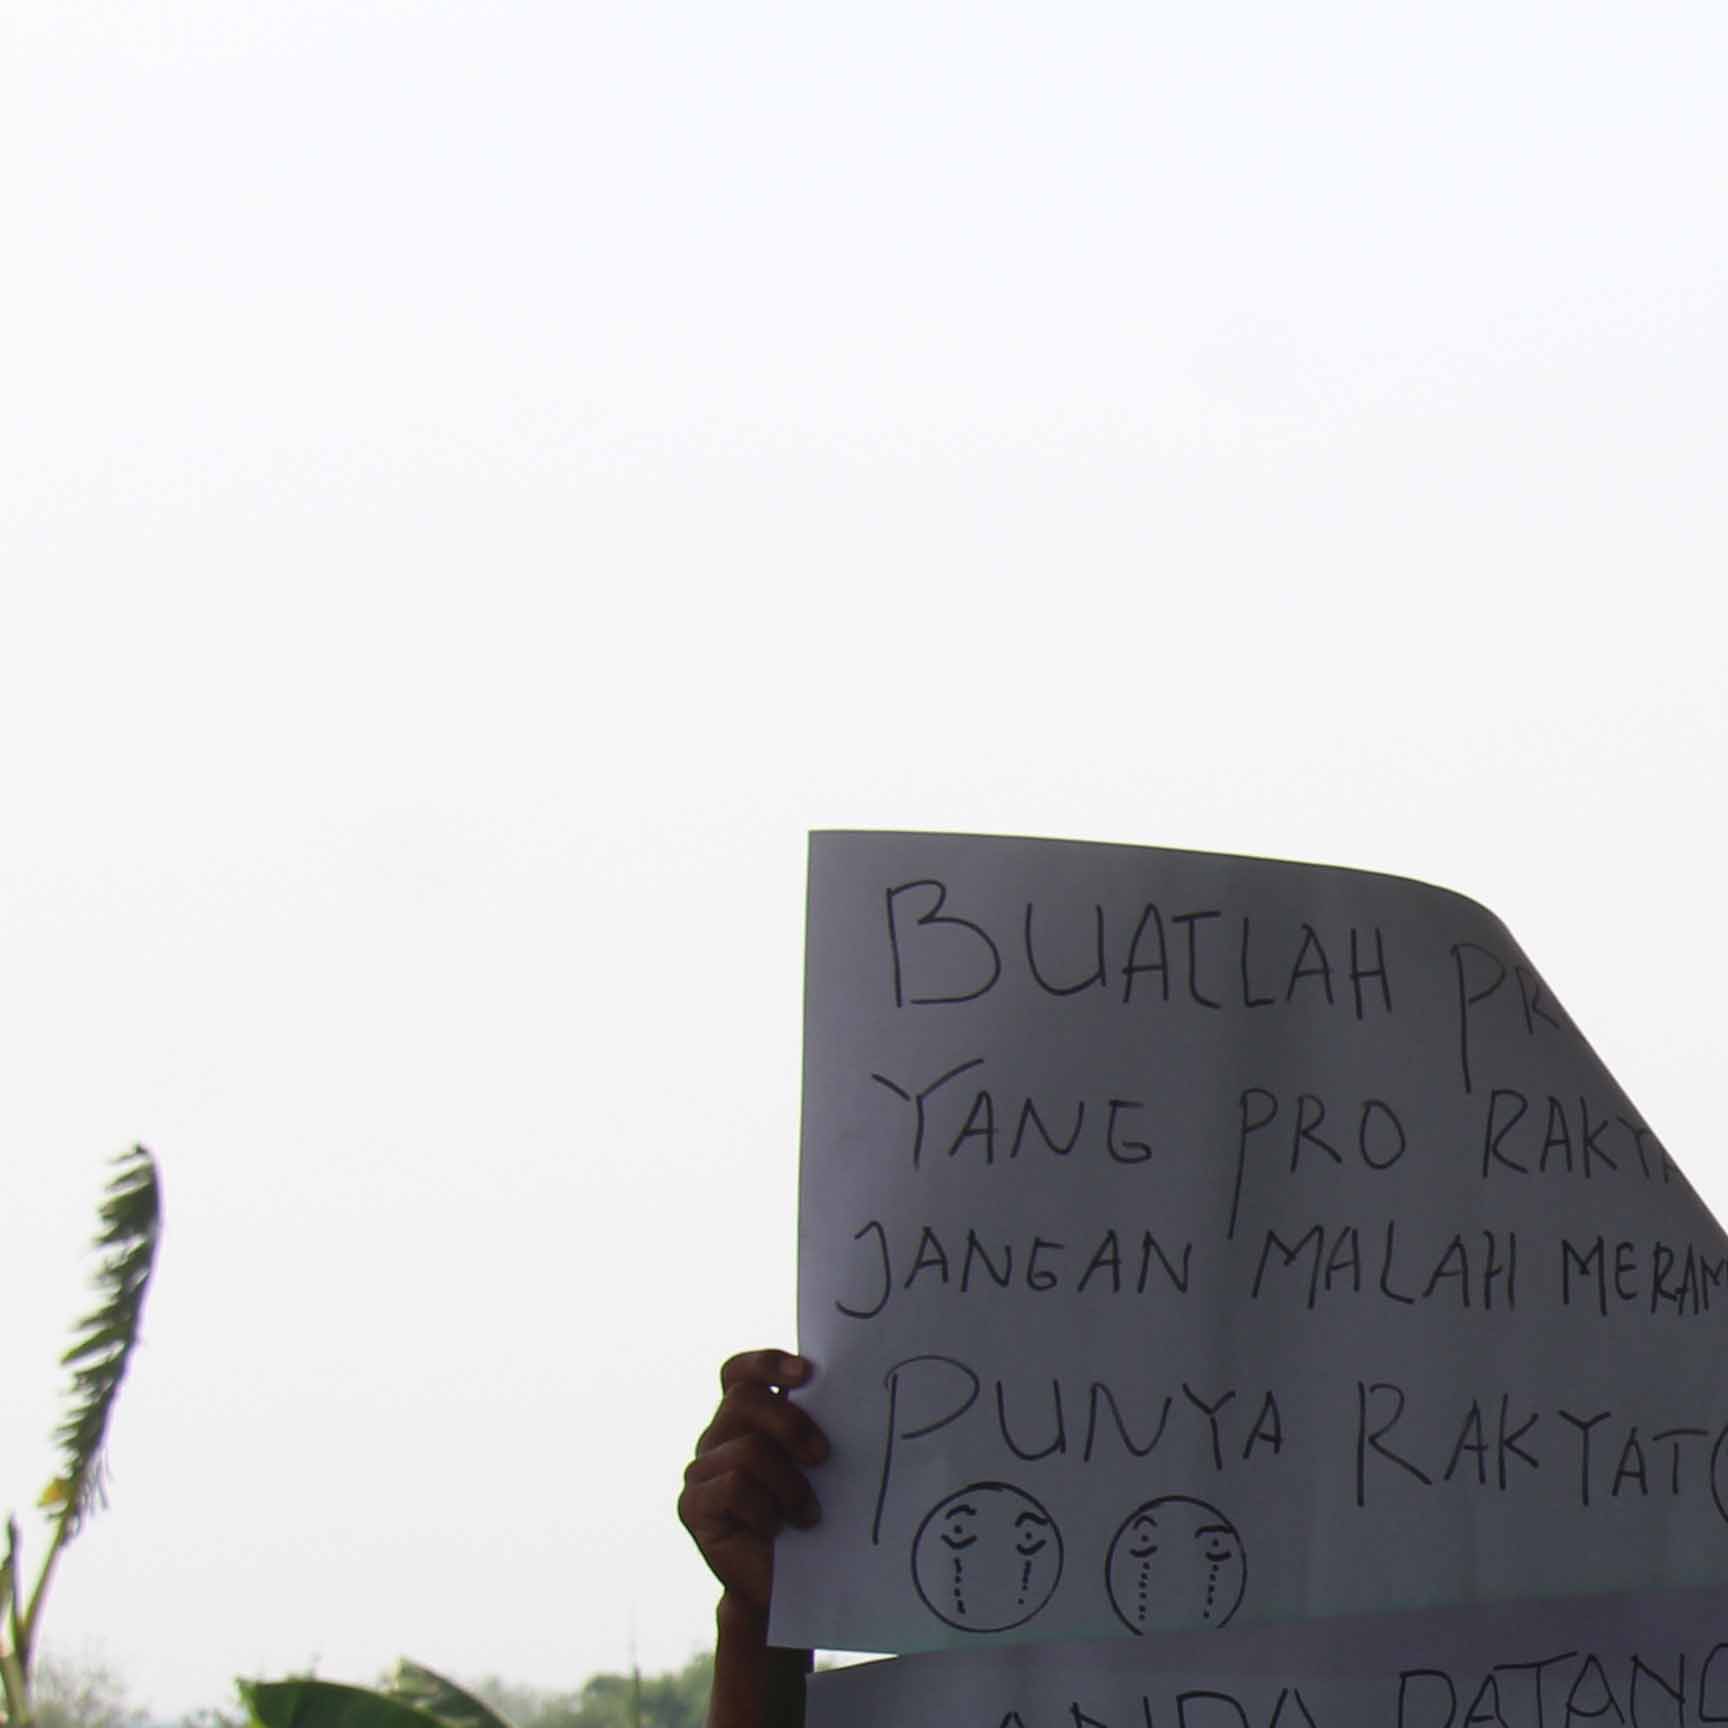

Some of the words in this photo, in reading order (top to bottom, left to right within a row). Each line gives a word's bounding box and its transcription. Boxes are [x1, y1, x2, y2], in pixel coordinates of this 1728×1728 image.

[885, 878, 1393, 1022] BUATLAH
[871, 1056, 1155, 1170] YANG
[1227, 1084, 1408, 1241] PRO
[834, 1223, 1196, 1322] JANGAN
[1250, 1220, 1518, 1314] MALAH
[870, 1353, 1287, 1547] PUNYA
[1354, 1381, 1709, 1510] RAKYAT
